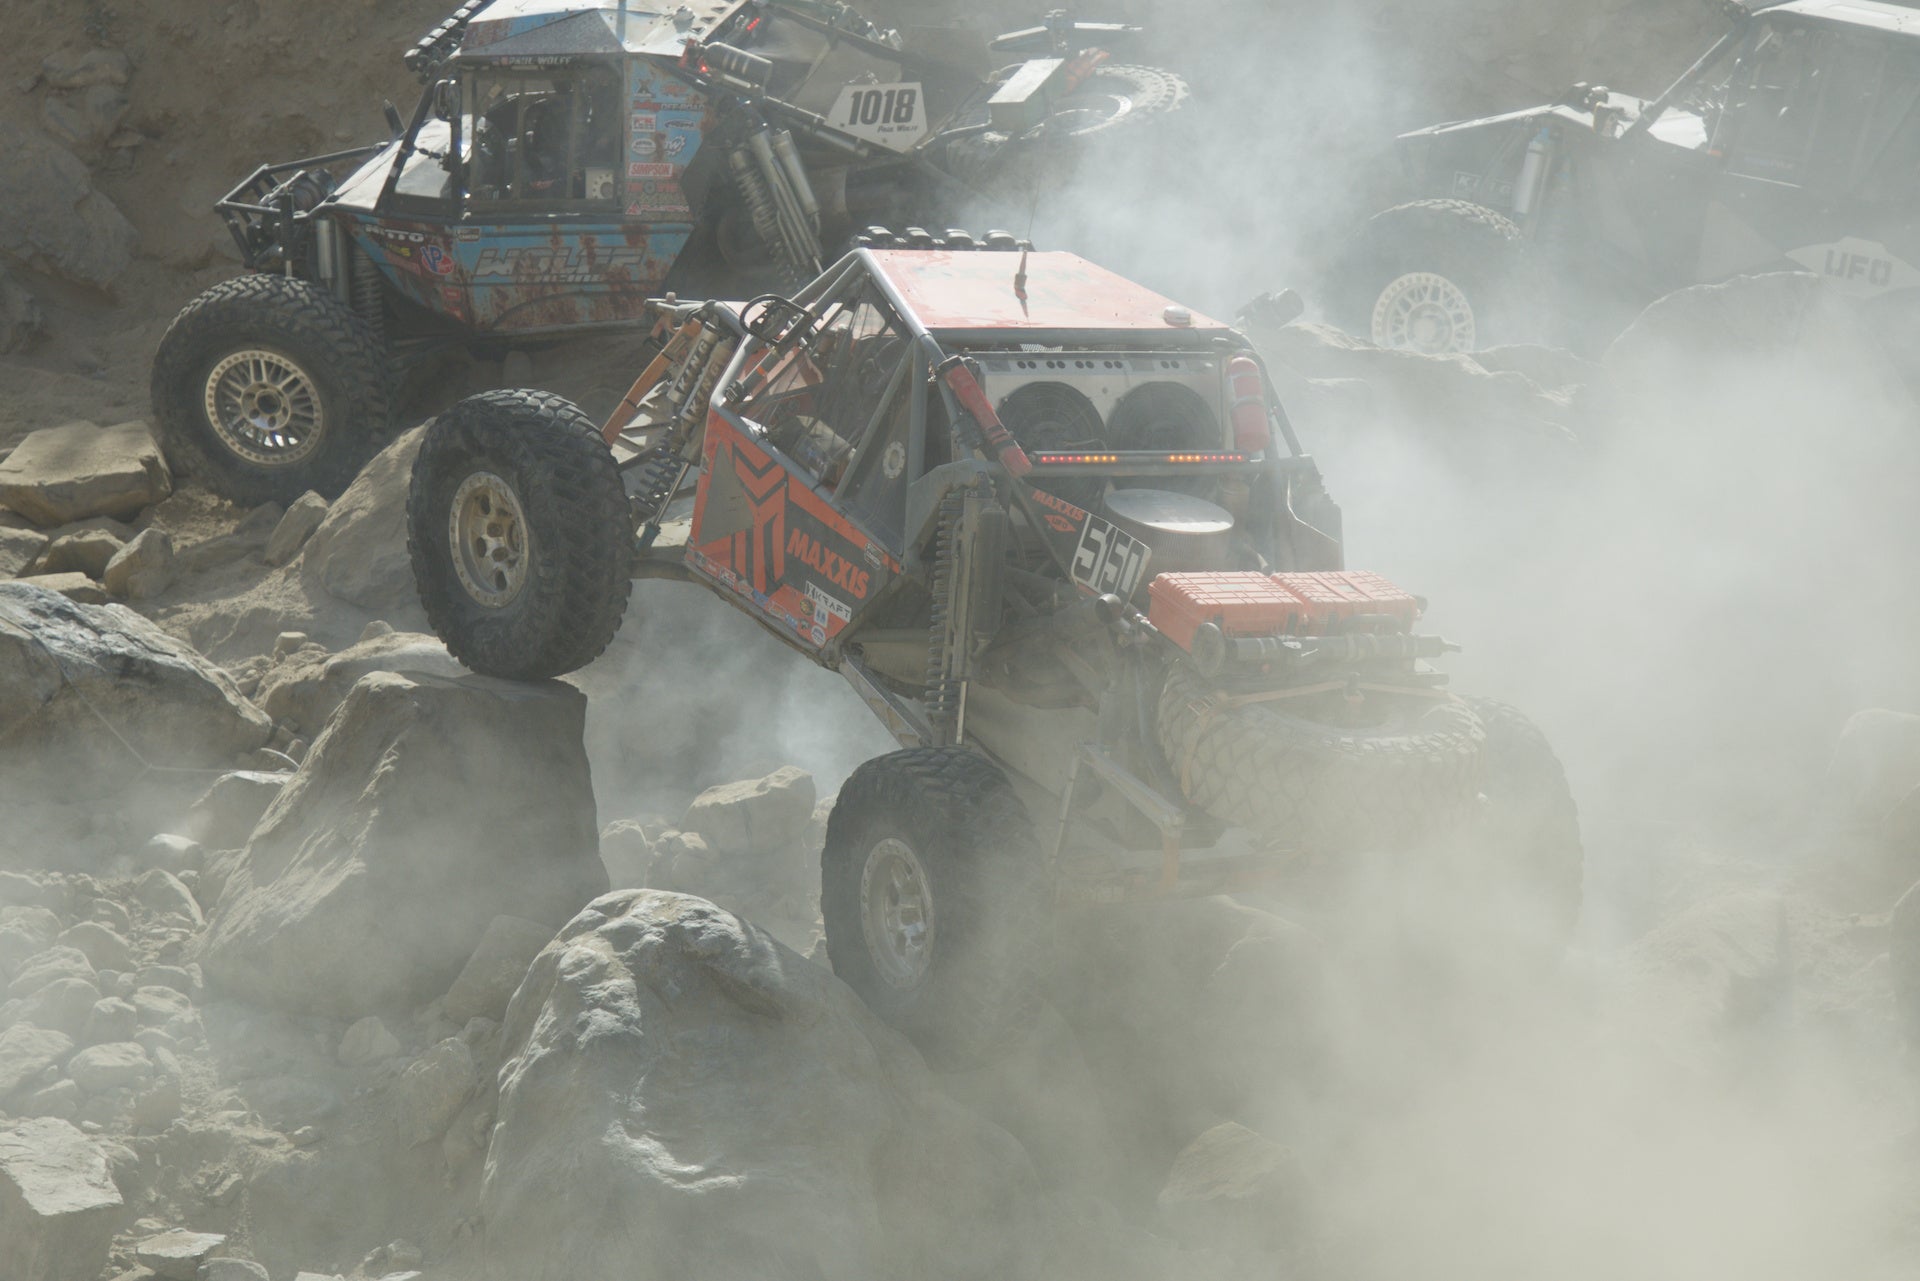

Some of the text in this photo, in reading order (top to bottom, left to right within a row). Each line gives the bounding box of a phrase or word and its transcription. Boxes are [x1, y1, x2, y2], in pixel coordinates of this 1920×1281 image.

[538, 56, 572, 65] WOLFF
[848, 88, 917, 126] 1018
[631, 164, 670, 175] SIMPSON
[1825, 249, 1893, 287] UFO
[677, 340, 709, 392] KING
[689, 363, 719, 413] KING
[1032, 489, 1086, 521] MAXXIS
[786, 527, 870, 600] MAXXIS
[1073, 514, 1145, 604] 5150
